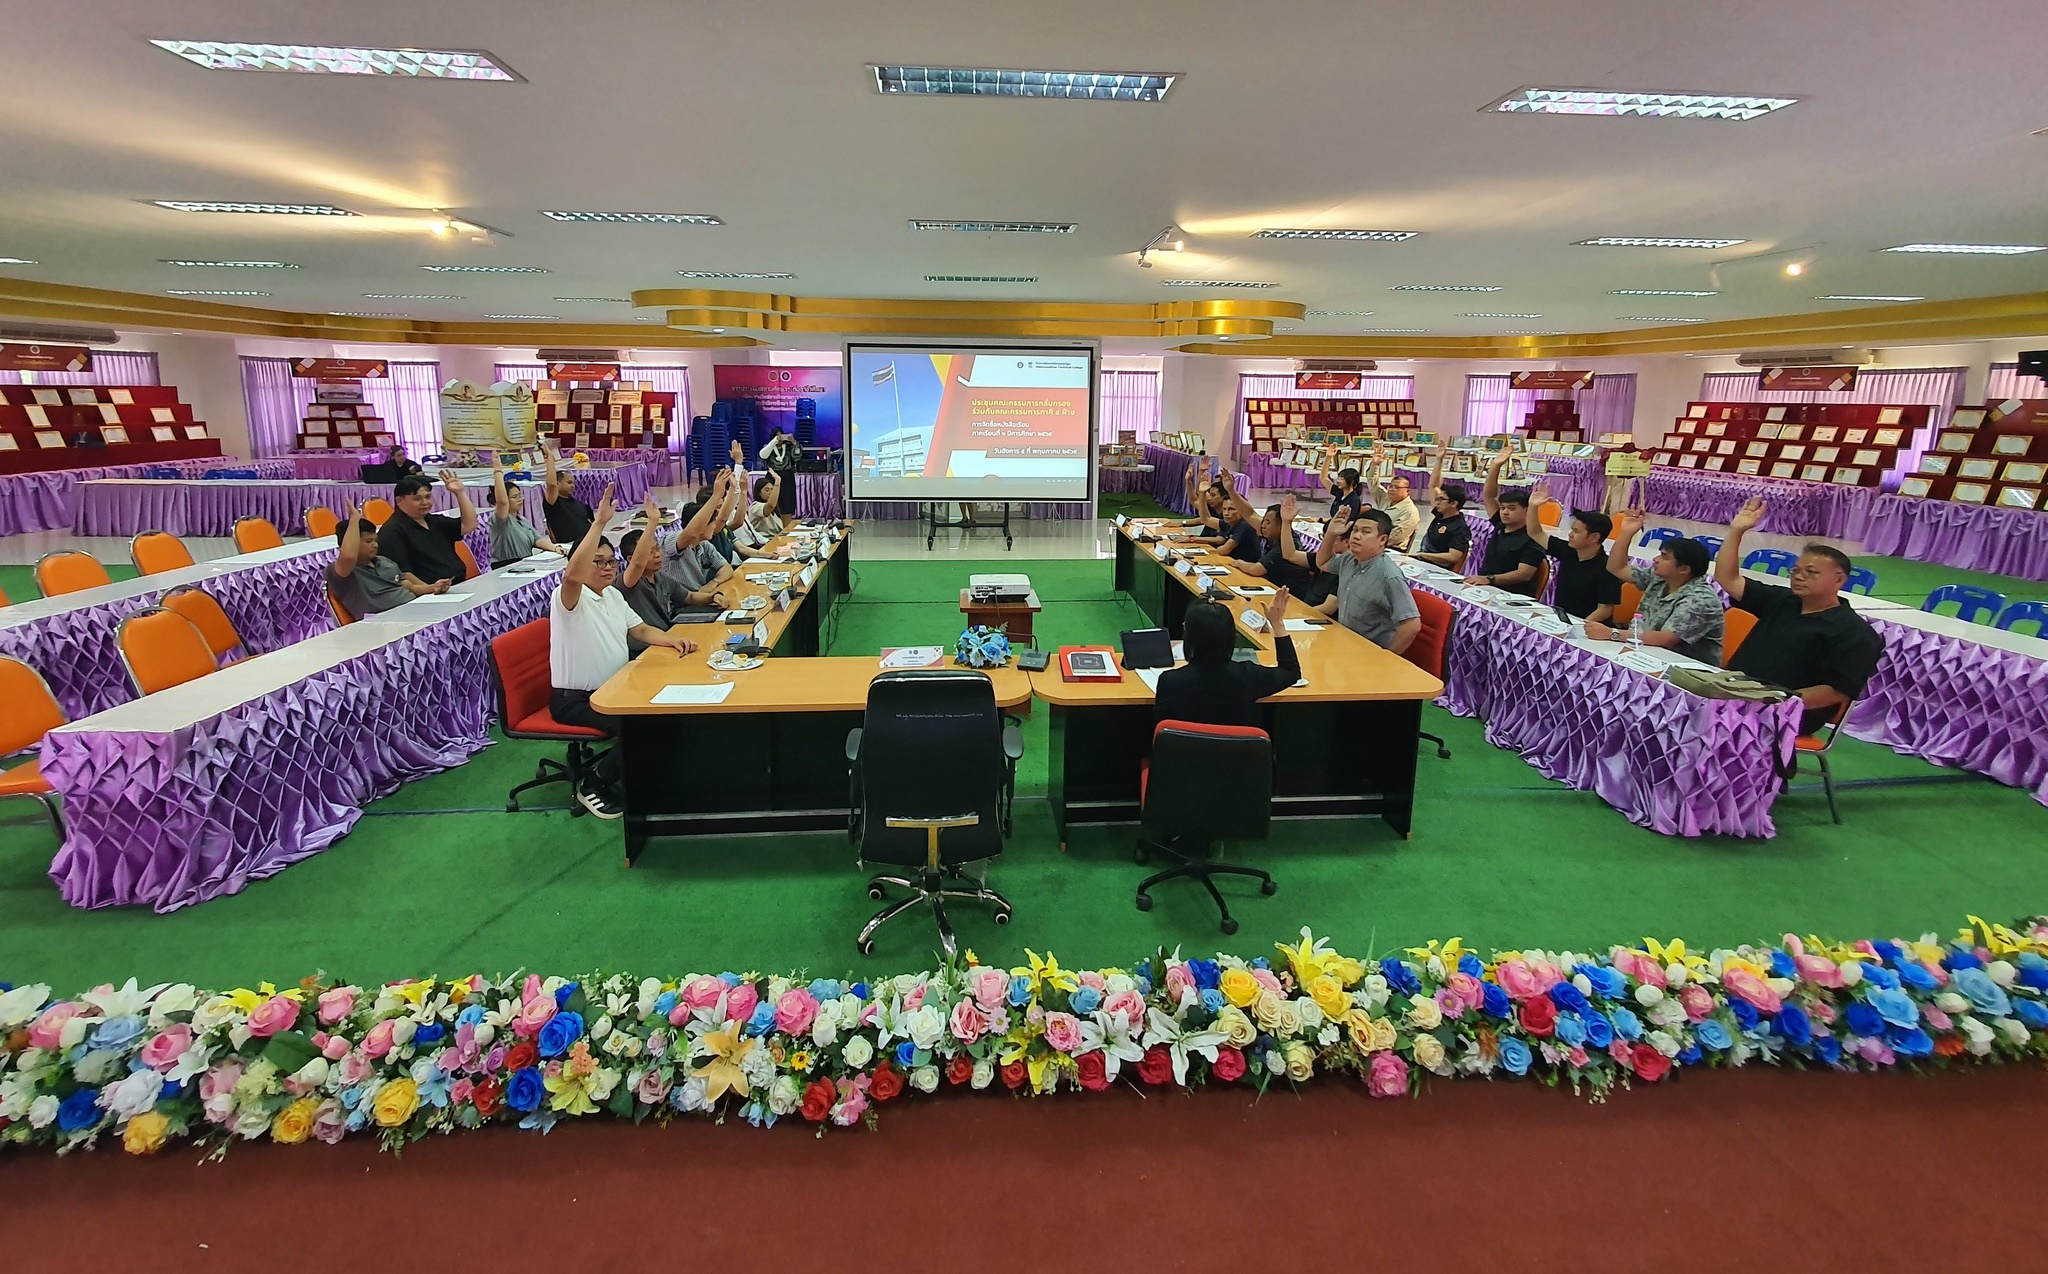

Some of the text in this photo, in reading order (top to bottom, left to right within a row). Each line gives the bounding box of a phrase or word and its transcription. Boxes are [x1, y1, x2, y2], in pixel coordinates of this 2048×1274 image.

[972, 398, 1071, 407] ประชุมคณะกรรมการกลั่นกรอง
